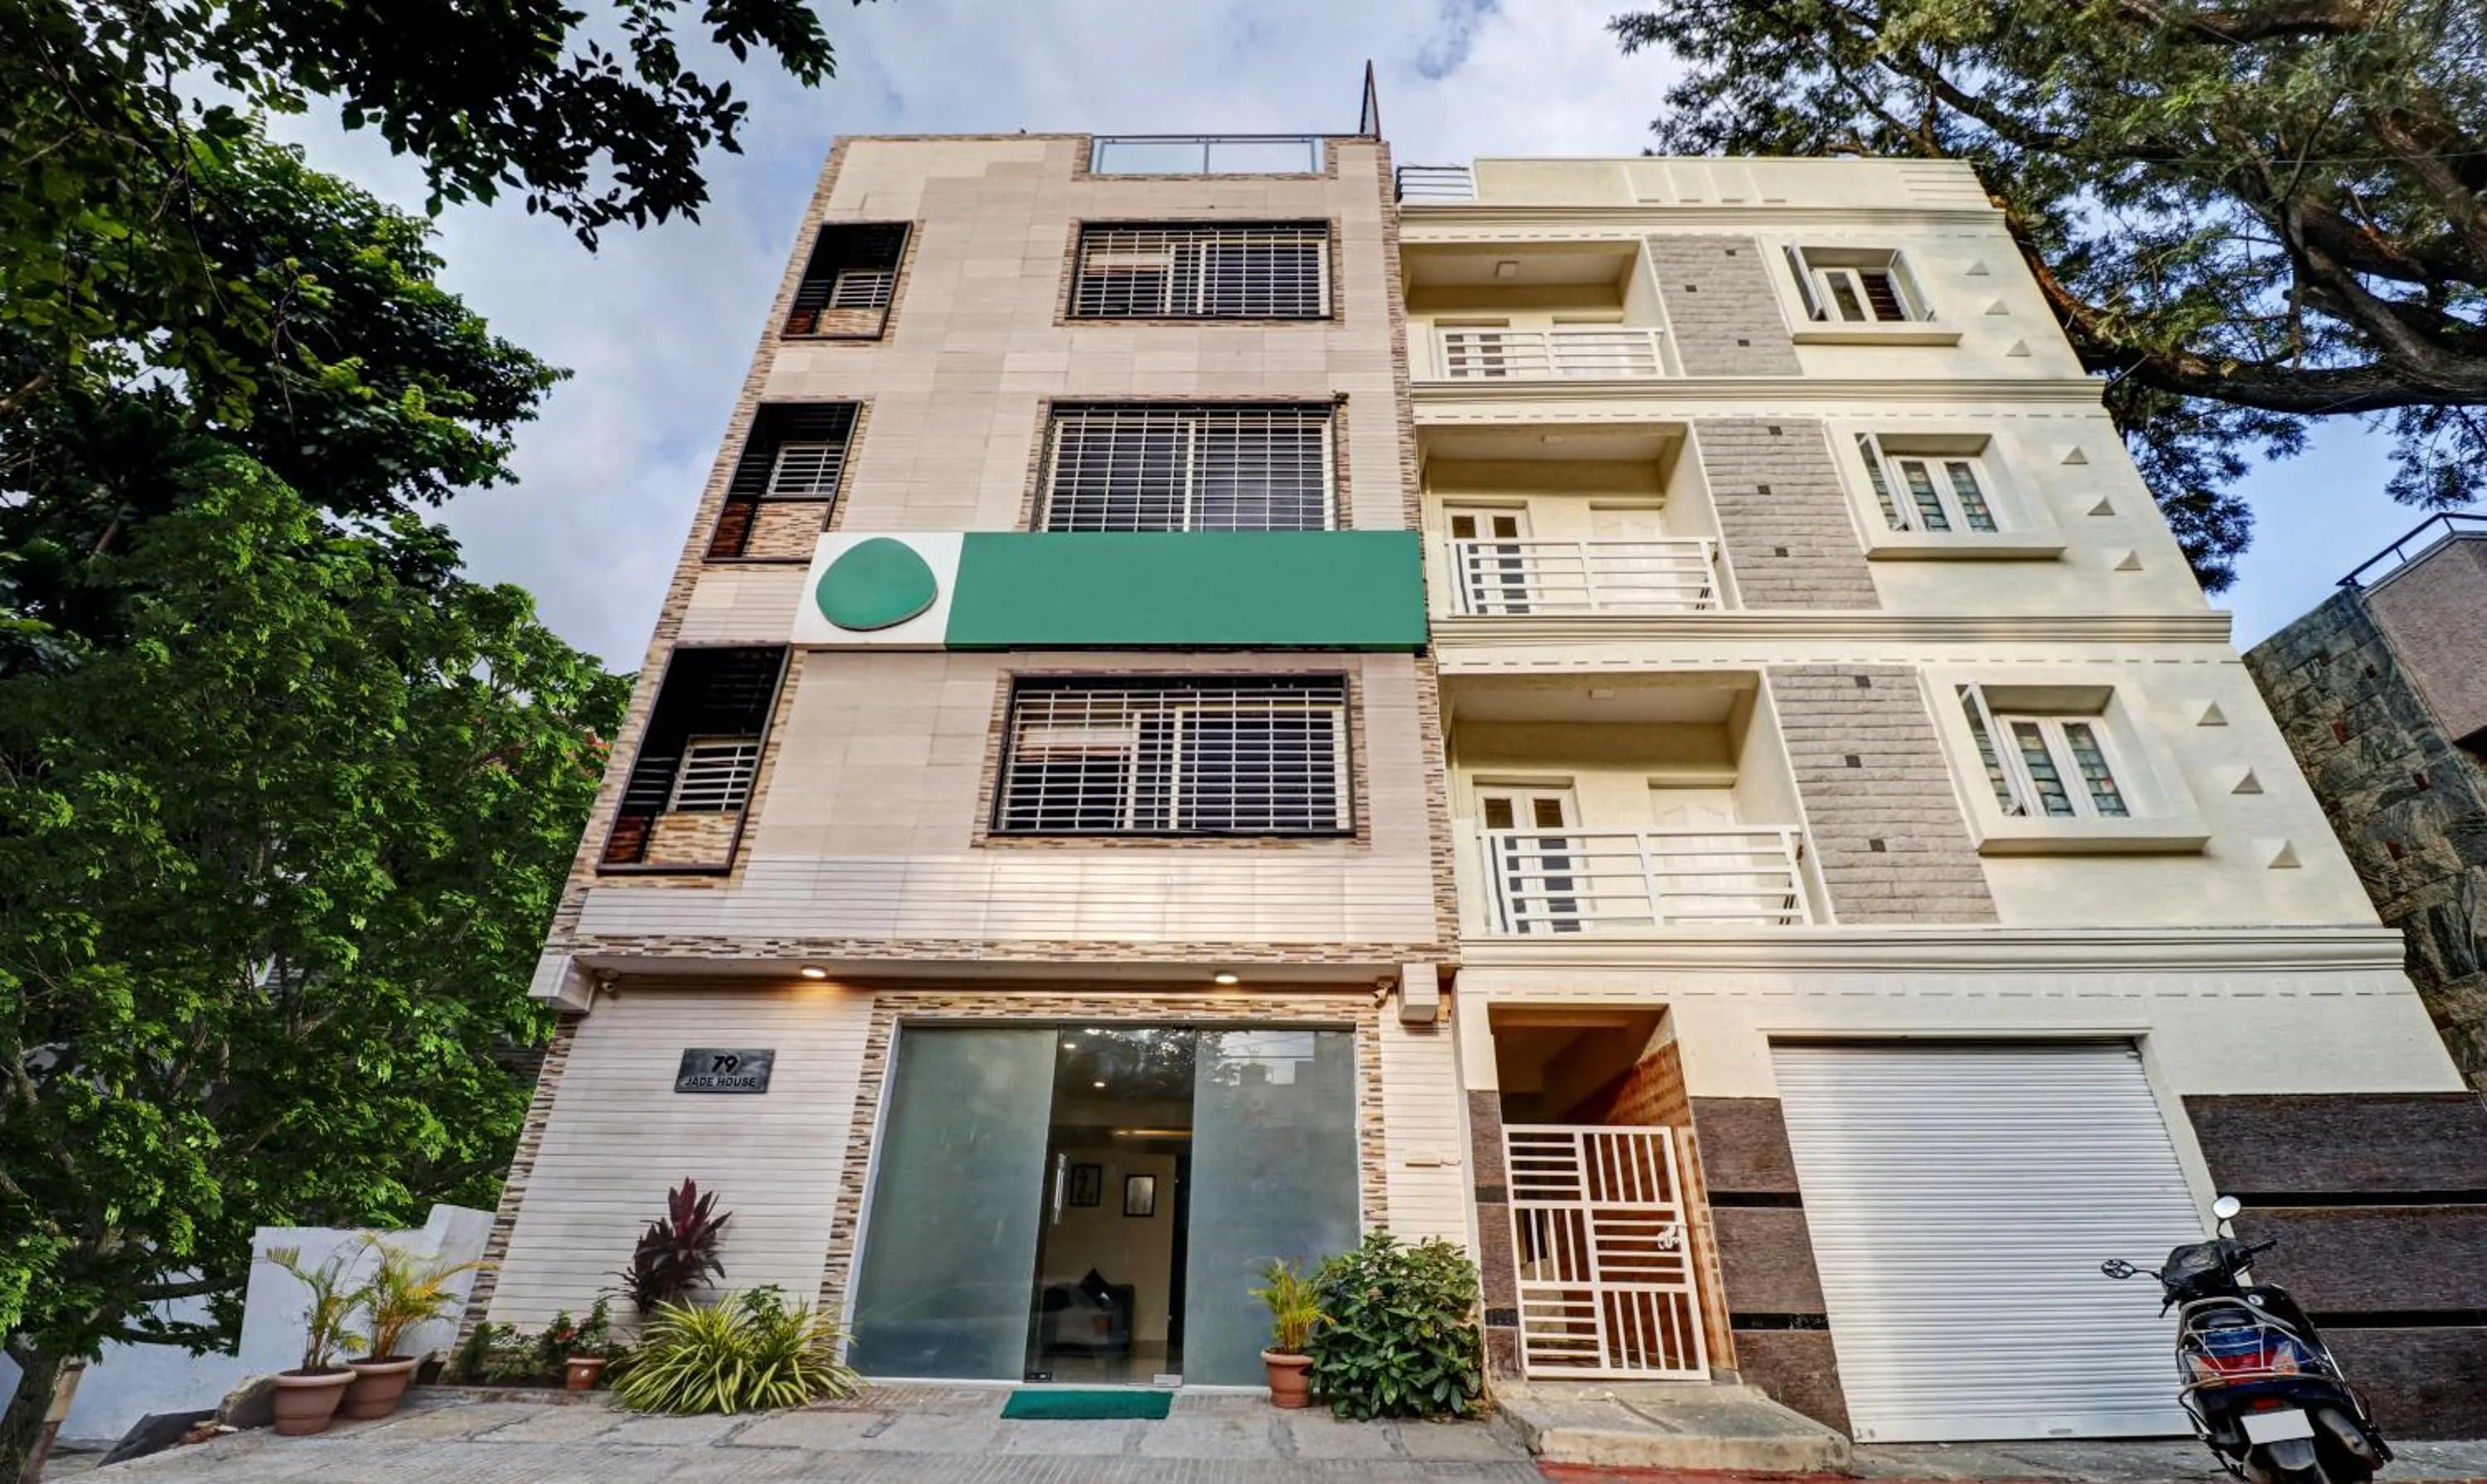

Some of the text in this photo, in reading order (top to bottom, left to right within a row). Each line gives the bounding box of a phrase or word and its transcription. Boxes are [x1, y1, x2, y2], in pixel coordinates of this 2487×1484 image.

[711, 1055, 739, 1073] 79
[685, 1077, 757, 1087] JADE HOUSE
